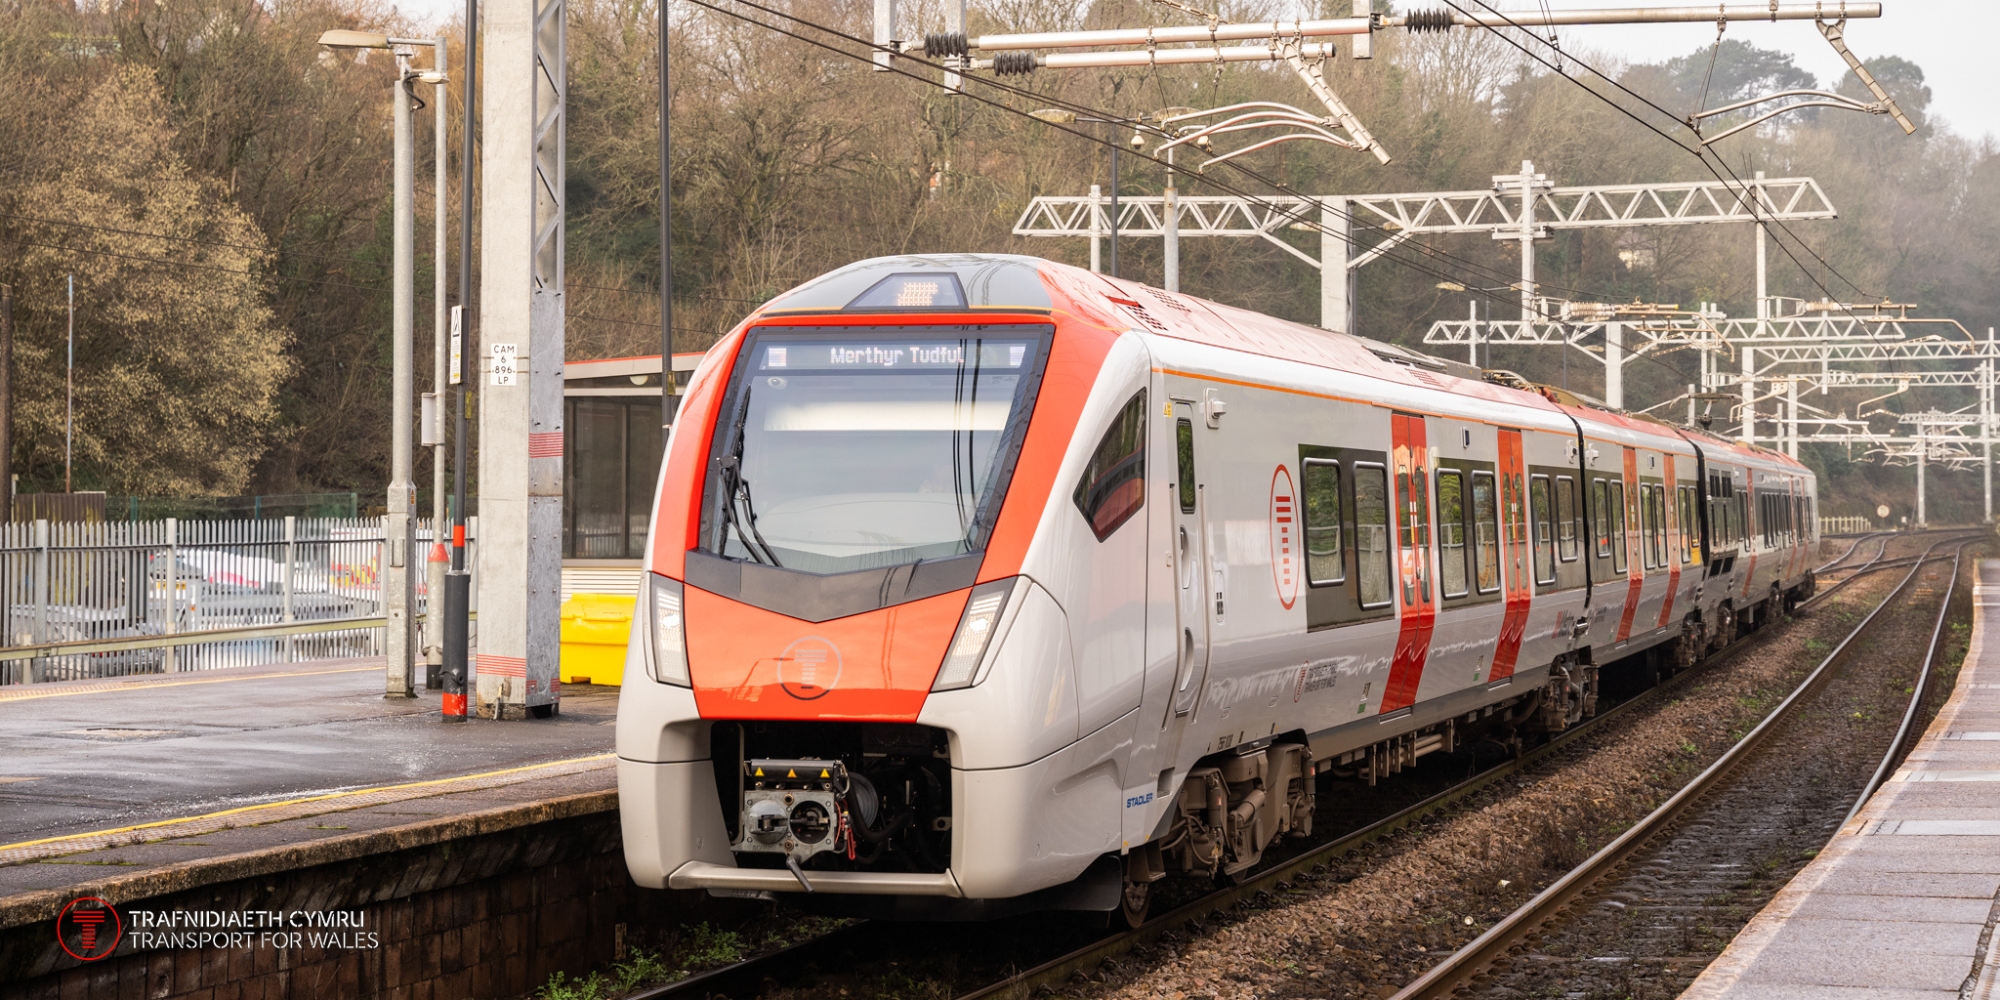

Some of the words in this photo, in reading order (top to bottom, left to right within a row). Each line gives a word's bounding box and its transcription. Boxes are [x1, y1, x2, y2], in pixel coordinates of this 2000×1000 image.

[493, 345, 515, 354] CAM
[500, 356, 507, 364] 6
[830, 347, 904, 366] Merthyr
[909, 346, 965, 364] Tudful
[495, 365, 512, 374] 896
[498, 376, 509, 385] LP
[1126, 793, 1153, 808] STADLER
